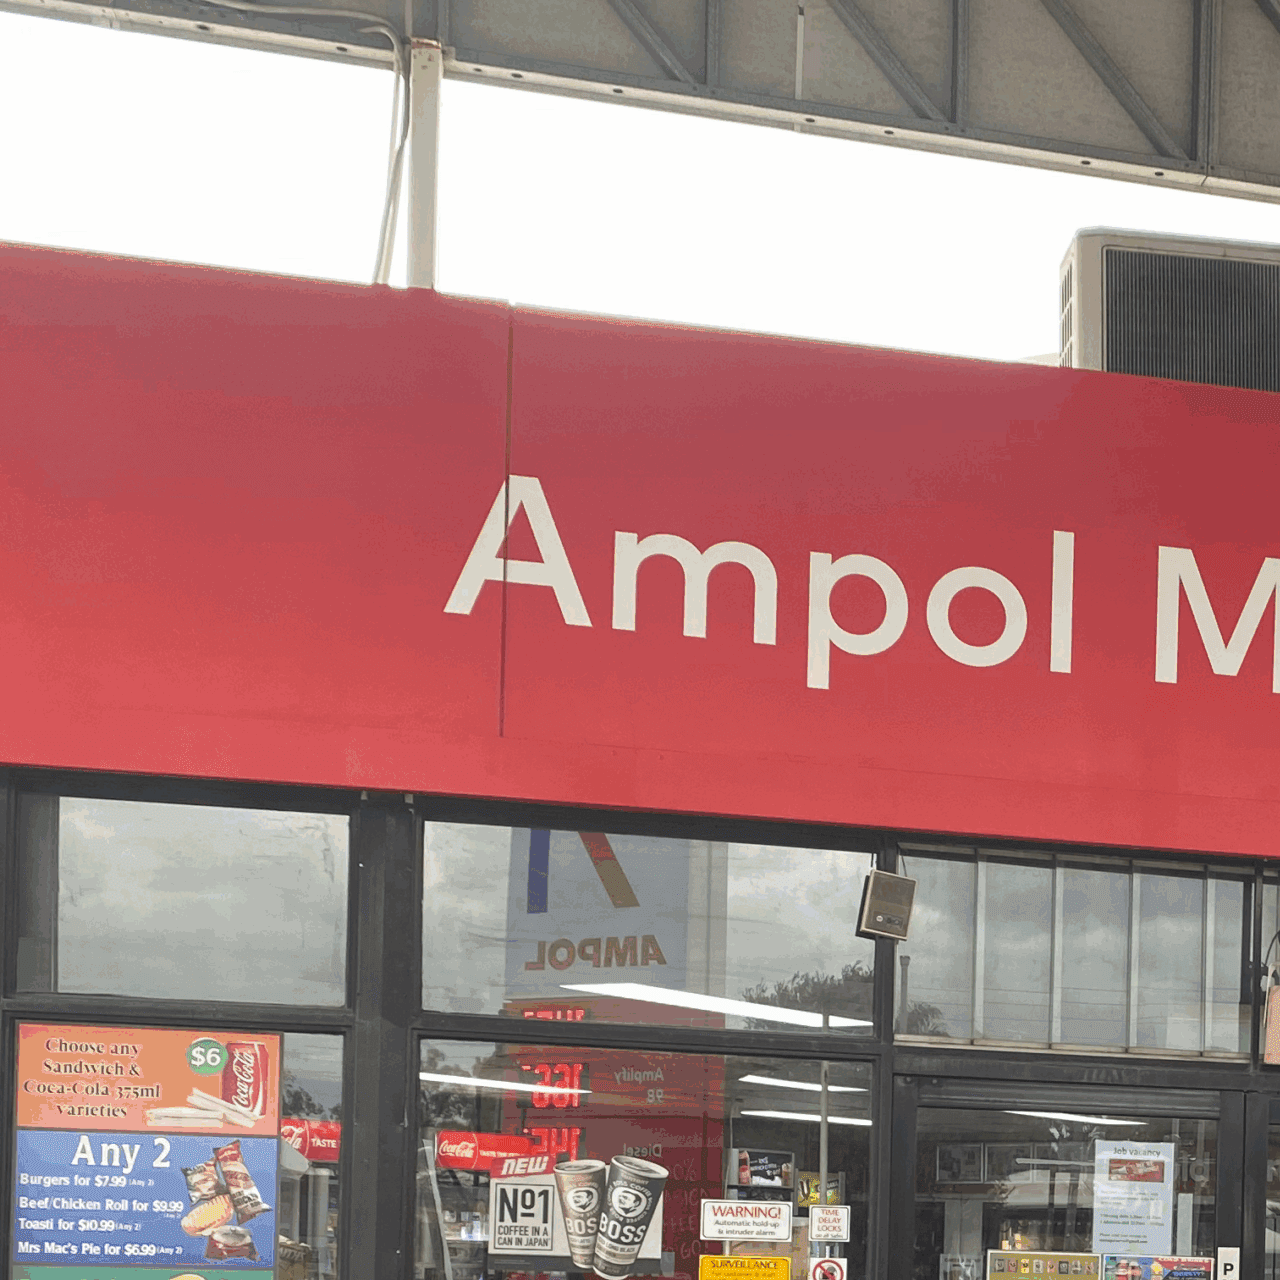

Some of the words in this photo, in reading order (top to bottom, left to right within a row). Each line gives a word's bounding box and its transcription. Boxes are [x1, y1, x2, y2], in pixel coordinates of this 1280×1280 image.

[443, 474, 1075, 689] Ampol
[45, 1038, 105, 1053] Choose
[110, 1044, 139, 1059] any
[191, 1046, 221, 1067] $6
[43, 1060, 124, 1075] Sandwich
[129, 1063, 140, 1076] &
[23, 1080, 110, 1096] Coca-Cola
[116, 1083, 160, 1099] 375ml
[311, 1138, 337, 1148] TASTE
[70, 1135, 141, 1175] Any
[152, 1137, 171, 1168] 2
[1113, 1147, 1127, 1155] Job
[501, 1156, 549, 1175] NEW
[19, 1173, 70, 1187] Burgers
[74, 1174, 91, 1186] for
[94, 1175, 127, 1187] $7.99
[19, 1196, 101, 1211] Beef/Chicken
[105, 1199, 128, 1211] Roll
[132, 1200, 149, 1211] for
[152, 1200, 184, 1212] $9.99
[712, 1205, 781, 1219] WARNING!
[18, 1217, 53, 1230] Toasti
[58, 1218, 75, 1230] for
[78, 1219, 115, 1231] $10.99
[497, 1225, 529, 1236] COFFEE
[532, 1226, 540, 1236] IN
[542, 1227, 548, 1236] A
[599, 1212, 647, 1243] BOSS
[714, 1219, 751, 1227] Automatic
[753, 1220, 779, 1229] hold-up
[725, 1228, 754, 1236] intruder
[17, 1241, 40, 1253] Mrs
[44, 1241, 78, 1254] Mac's
[81, 1243, 100, 1254] Pie
[104, 1243, 121, 1255] for
[124, 1244, 156, 1256] $6.99
[497, 1236, 513, 1246] CAN
[515, 1237, 522, 1246] IN
